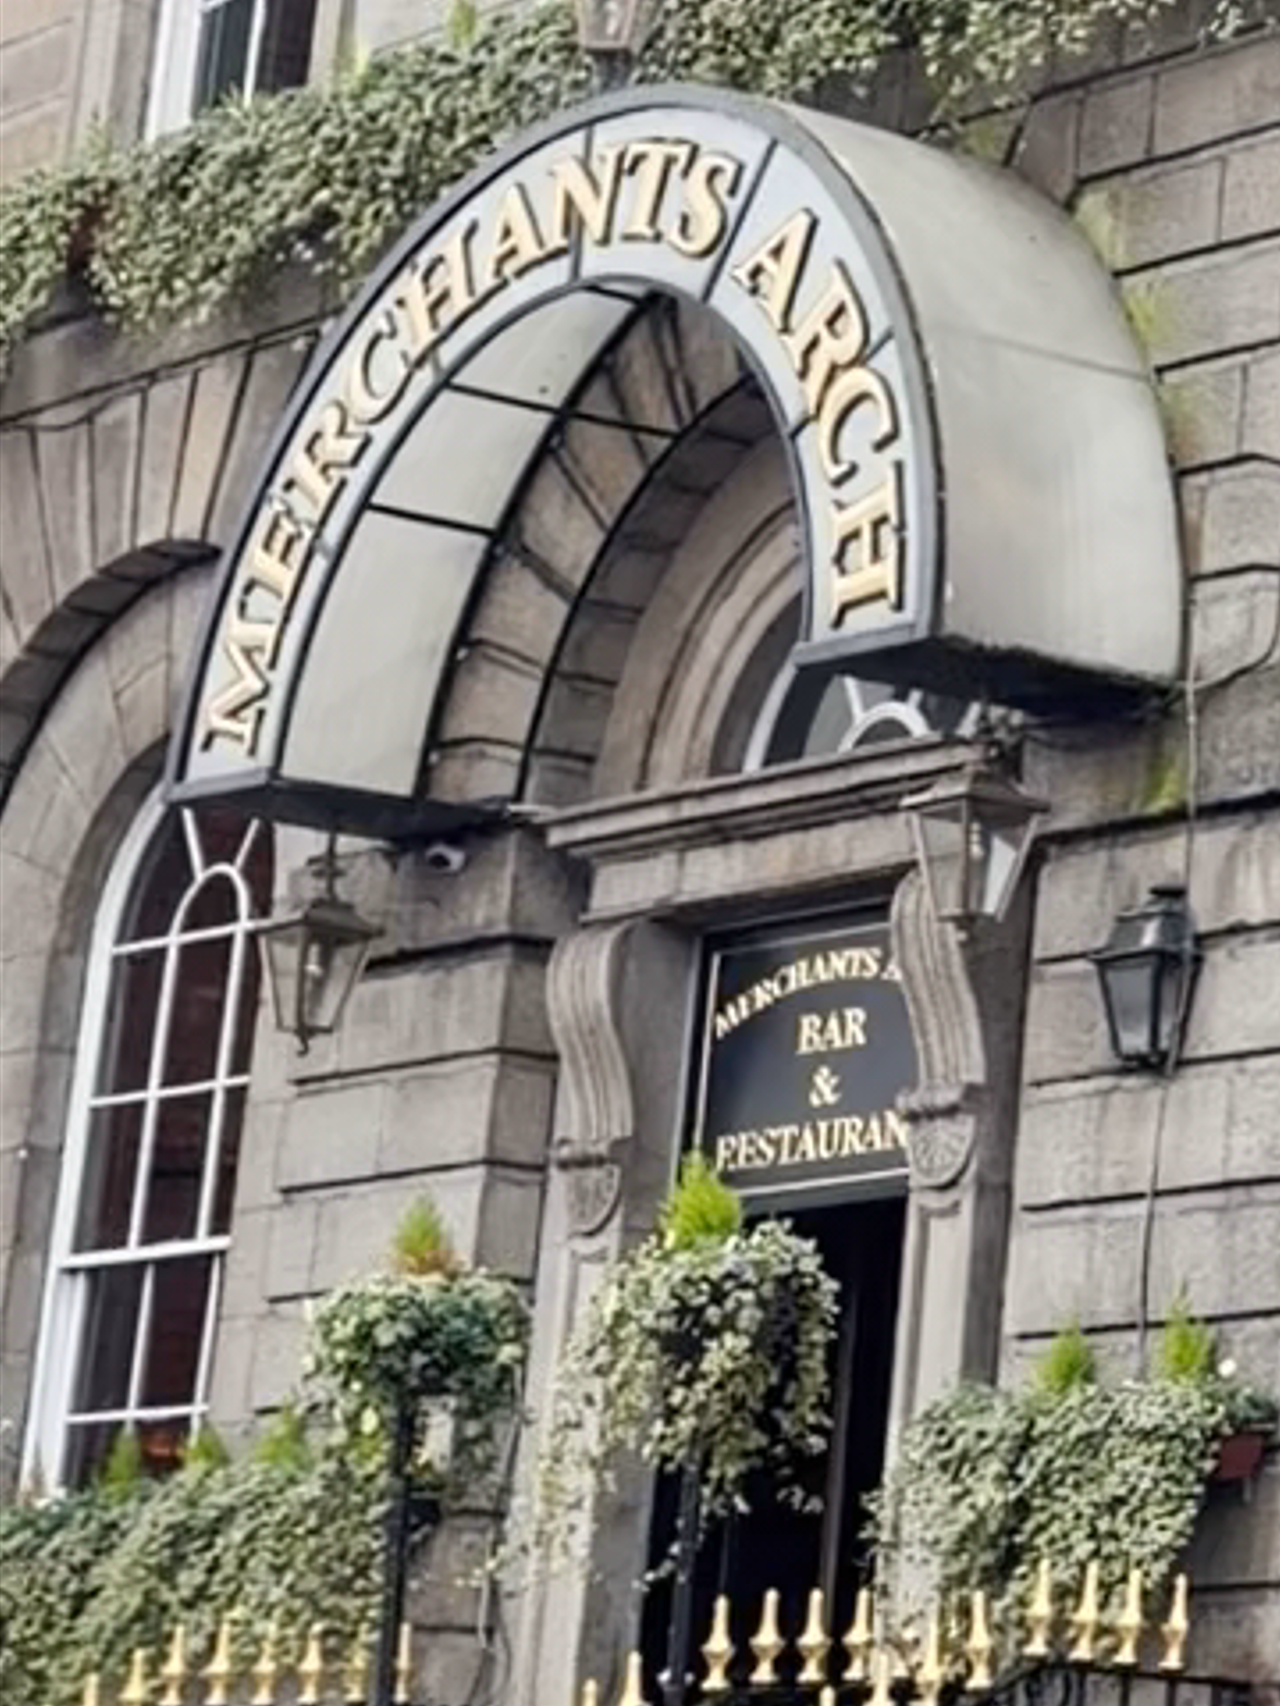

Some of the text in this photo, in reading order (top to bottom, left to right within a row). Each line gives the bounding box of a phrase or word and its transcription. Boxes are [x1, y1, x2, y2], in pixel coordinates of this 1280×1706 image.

[202, 138, 907, 756] MERCHANTS ARCH
[714, 947, 884, 1039] MERCHANTS
[796, 1007, 868, 1055] BAR
[808, 1065, 842, 1108] &
[714, 1109, 909, 1172] RESTAURAN
